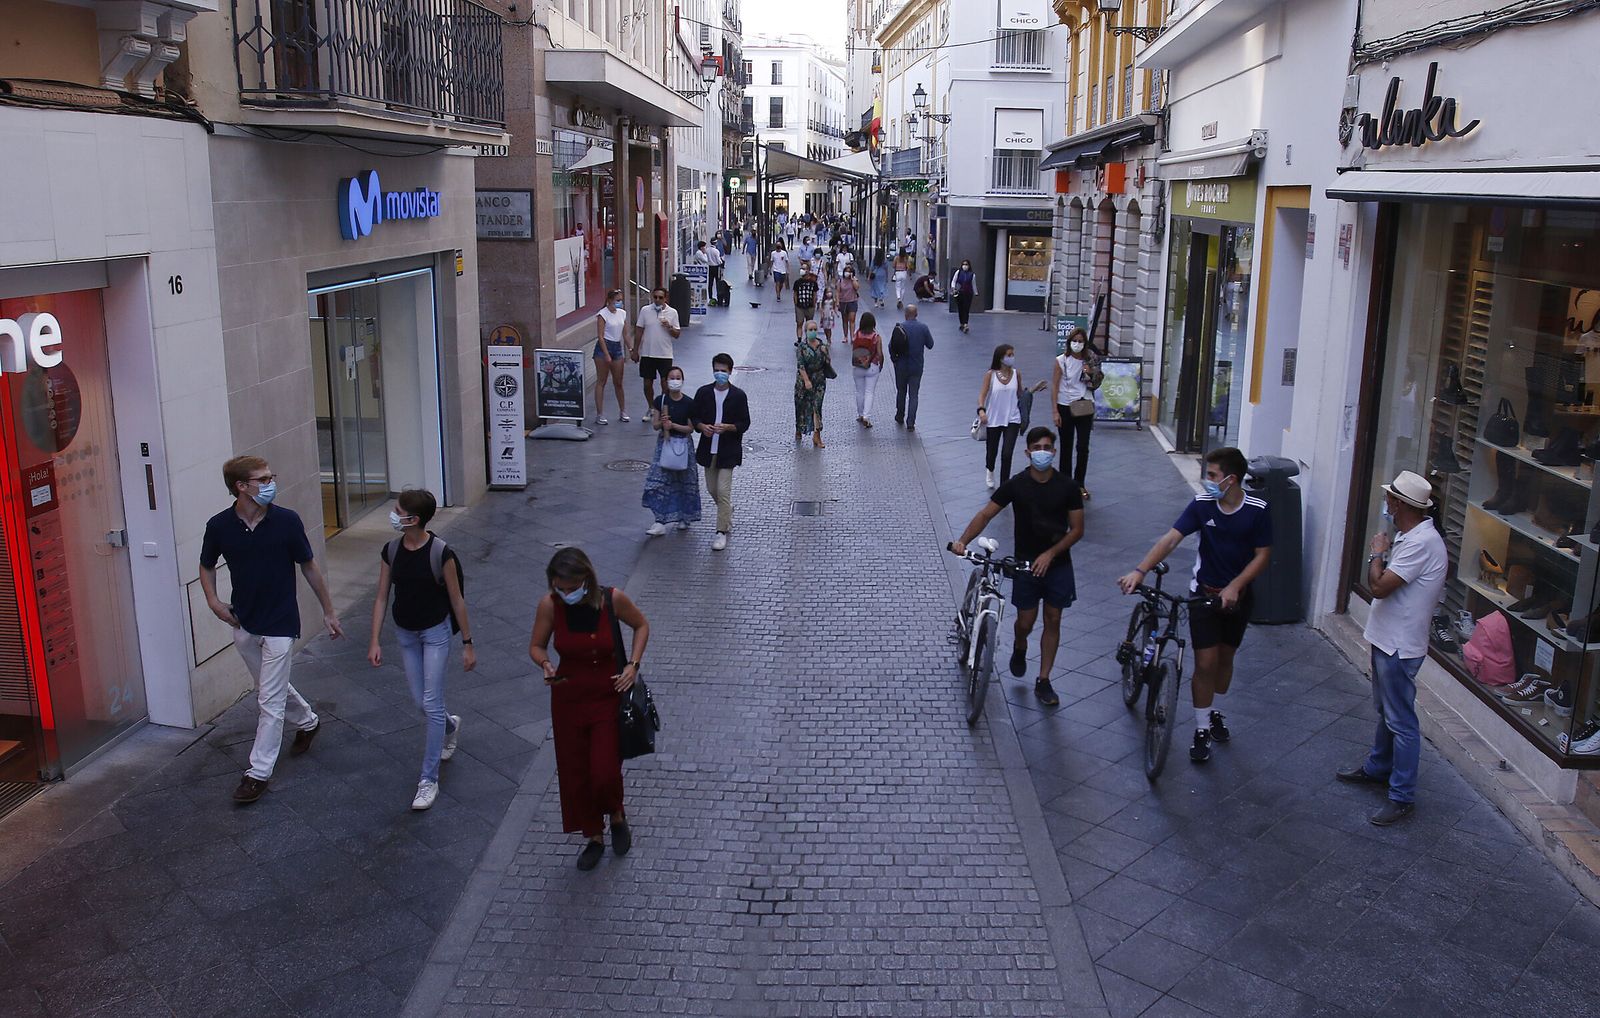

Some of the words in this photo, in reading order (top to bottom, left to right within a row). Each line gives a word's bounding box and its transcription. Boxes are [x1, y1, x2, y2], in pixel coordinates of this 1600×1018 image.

[1204, 183, 1229, 203] ROCHER
[386, 187, 441, 220] movistar
[168, 275, 183, 295] 16
[28, 468, 49, 485] ¡Hola!
